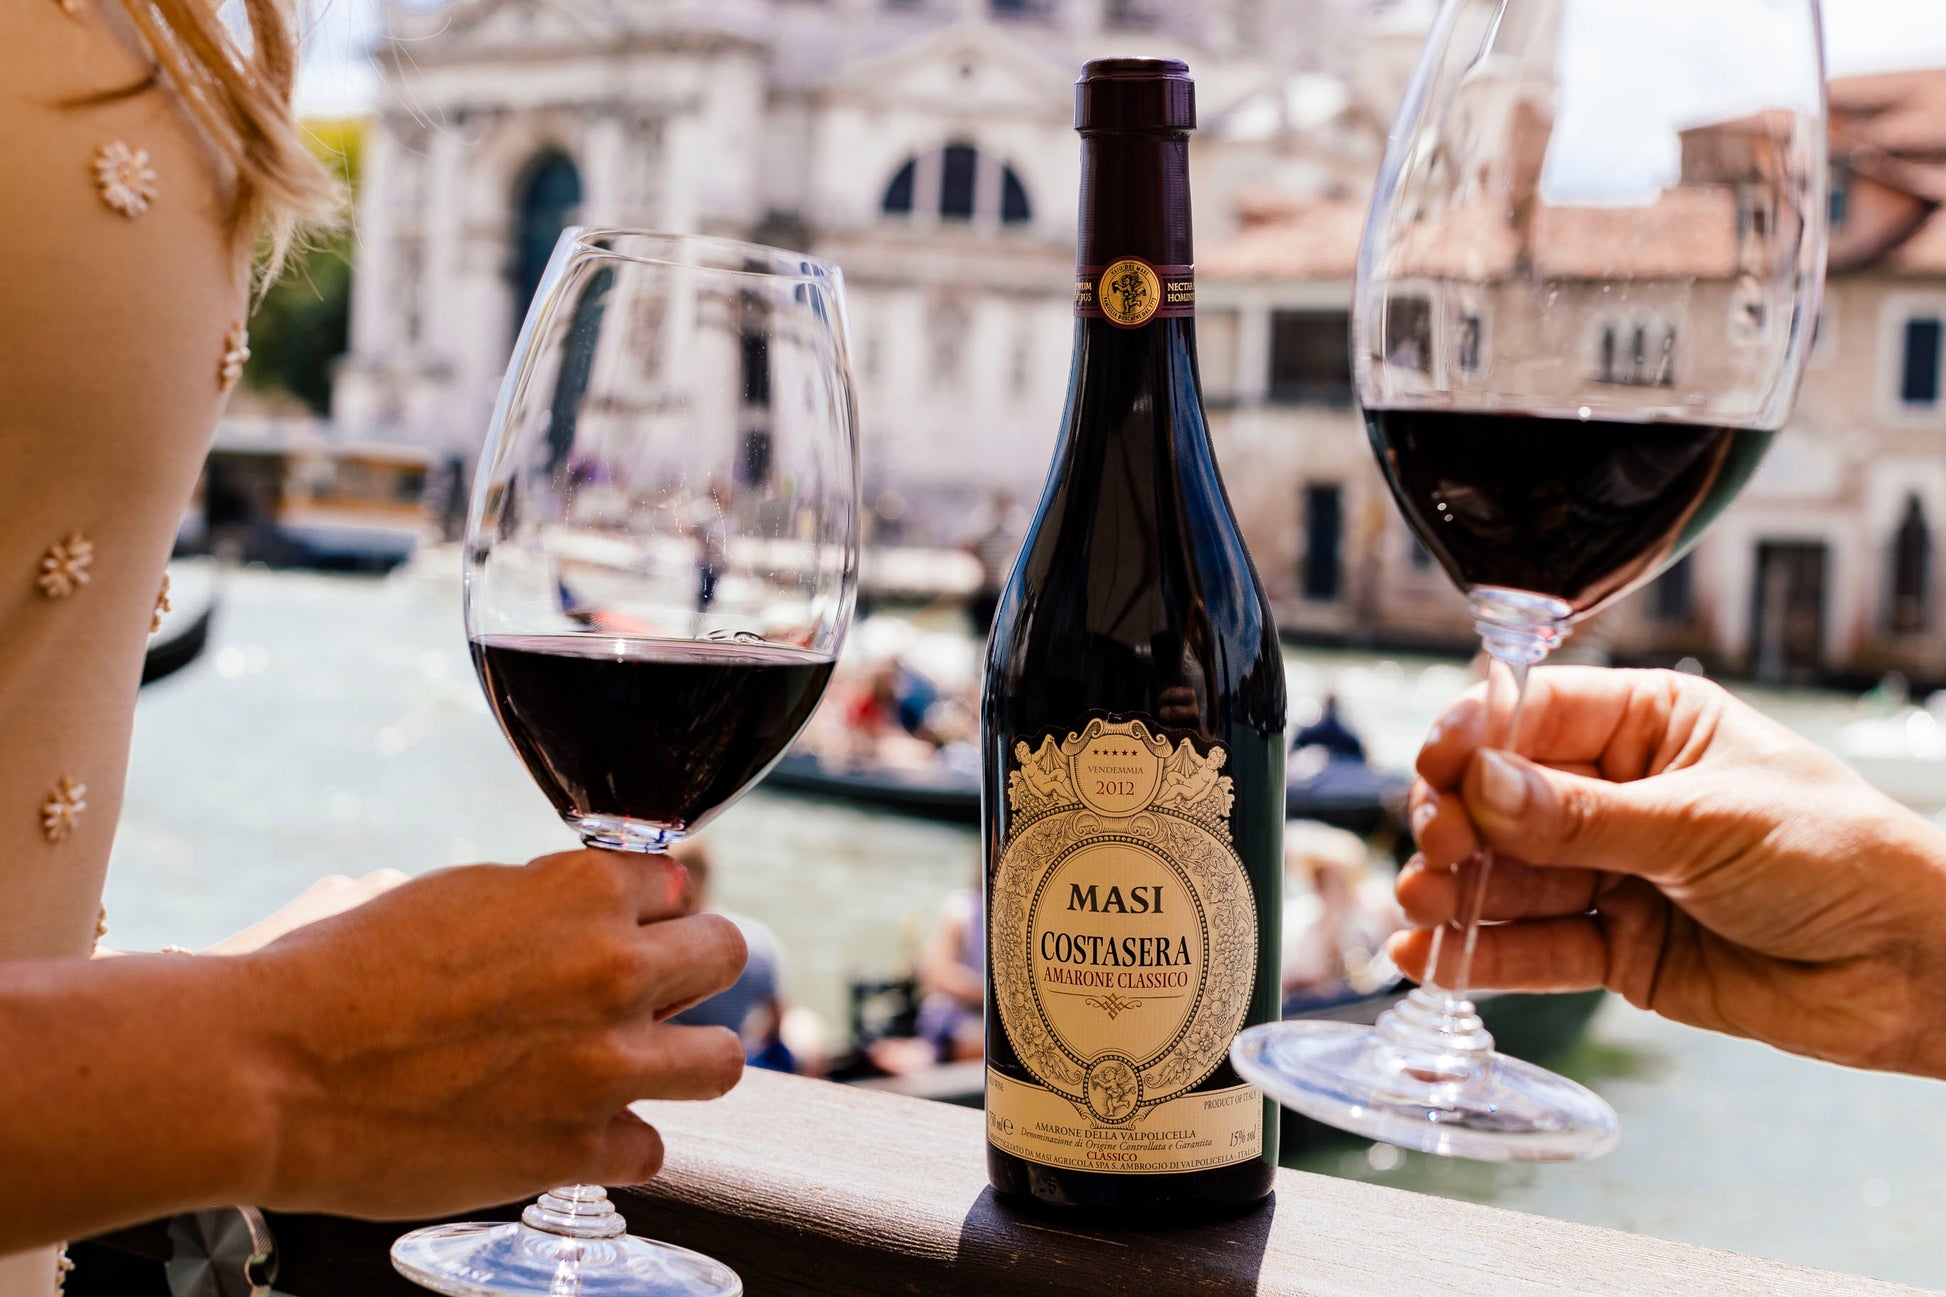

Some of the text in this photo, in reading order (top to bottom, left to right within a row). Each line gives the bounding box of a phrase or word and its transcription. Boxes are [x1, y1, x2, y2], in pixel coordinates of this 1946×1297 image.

[1088, 765, 1144, 775] VENDEMMIA
[1096, 780, 1135, 796] 2012
[1066, 883, 1164, 914] MASI
[1041, 931, 1192, 967] COSTASERA
[1044, 966, 1188, 989] AMARONE CLASSICO
[1204, 1096, 1234, 1110] PRODUCT
[1235, 1094, 1242, 1104] OF
[1020, 1126, 1072, 1147] Denominazione
[1075, 1138, 1082, 1148] di
[1086, 1140, 1117, 1152] Origine
[1120, 1142, 1166, 1151] Controllata
[1175, 1138, 1213, 1150] Garantita
[1035, 1122, 1196, 1141] AMARONE DELLA VALPOLICELLA
[1230, 1124, 1257, 1147] 15% vol
[1025, 1148, 1034, 1158] DA
[1035, 1152, 1052, 1162] MASI
[1053, 1156, 1093, 1168] AGRICOLA
[1120, 1162, 1168, 1170] AMBROGIO
[1181, 1154, 1234, 1168] VALPOLICELLA
[1238, 1147, 1257, 1159] ITALIA
[1086, 1151, 1138, 1161] CLASSICO
